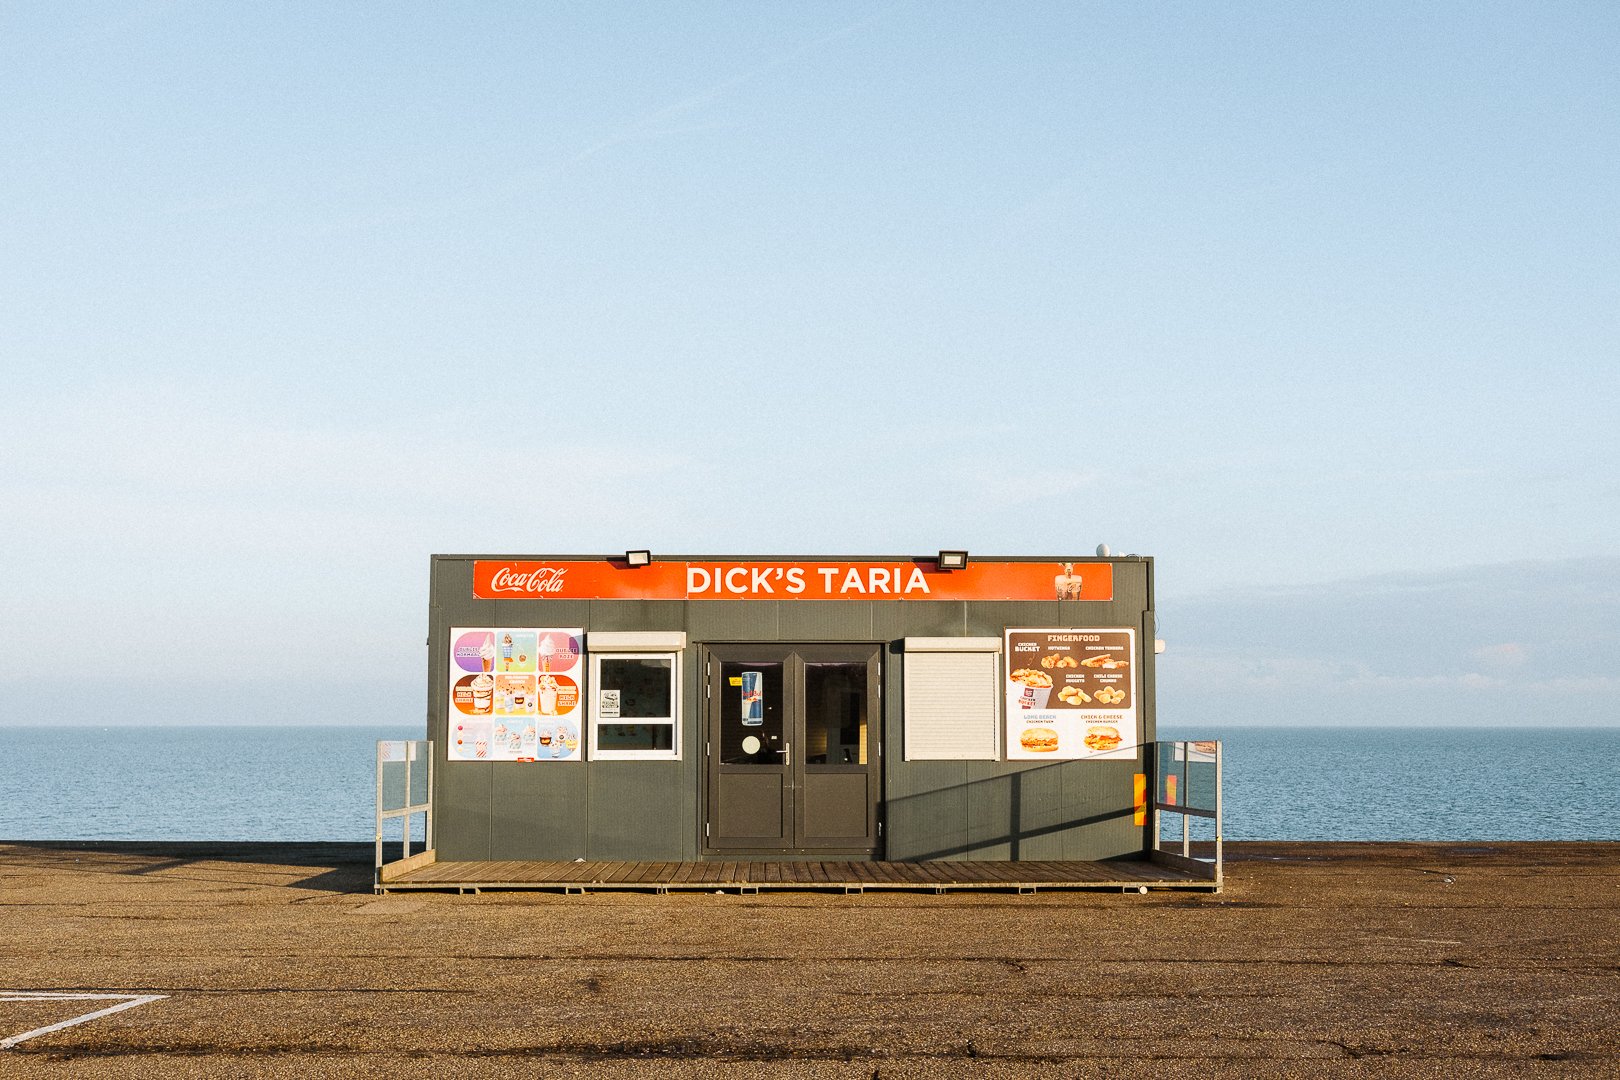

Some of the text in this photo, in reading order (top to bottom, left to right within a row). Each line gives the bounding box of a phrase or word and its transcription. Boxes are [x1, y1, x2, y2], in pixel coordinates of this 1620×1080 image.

[491, 567, 569, 593] Coca-Cola
[687, 567, 931, 594] DICK'S TARIA
[1047, 634, 1101, 642] FINGERFOOD
